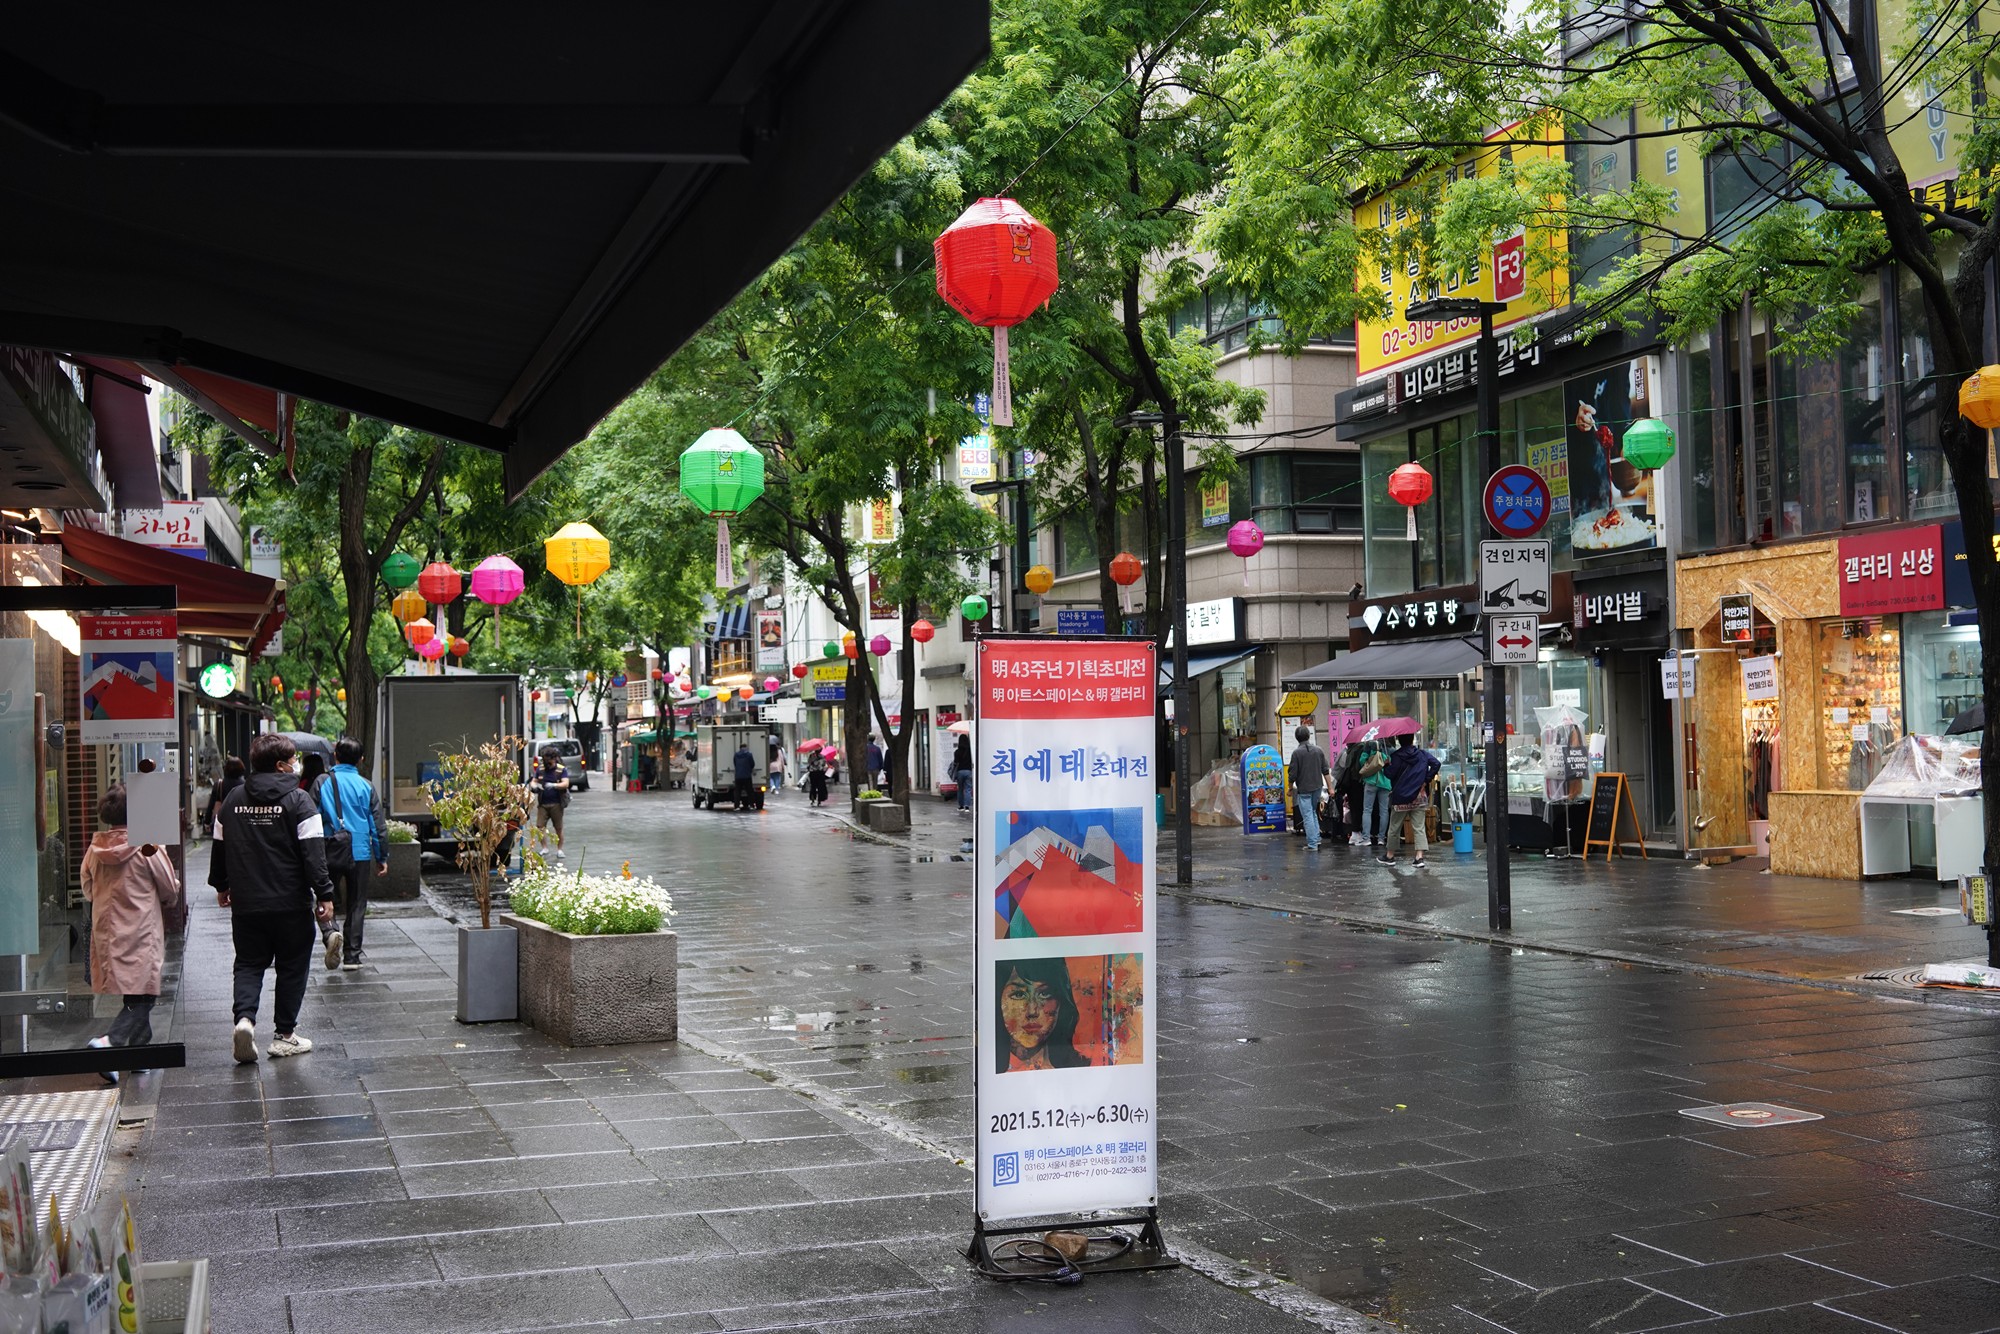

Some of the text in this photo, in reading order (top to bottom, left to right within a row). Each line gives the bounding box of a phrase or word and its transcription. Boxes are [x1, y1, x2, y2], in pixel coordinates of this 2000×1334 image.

[1498, 250, 1521, 284] F3
[1404, 353, 1464, 398] 비와별
[1532, 448, 1548, 465] 상가
[1496, 495, 1543, 507] 주정차금지
[1485, 548, 1546, 564] 견인지역
[1845, 548, 1935, 583] 갤러리 신상
[1386, 600, 1458, 630] 수정공방
[1585, 591, 1642, 624] 비와별
[1059, 612, 1087, 621] 인사동길
[138, 627, 163, 637] 초대전
[1498, 620, 1532, 632] 구간내
[1504, 651, 1527, 660] 100m
[992, 658, 1146, 679] 明 43주년 기획초대전
[1309, 683, 1323, 691] Silver
[1336, 681, 1359, 691] Amethyst
[1373, 681, 1387, 690] Pearl
[1403, 680, 1424, 690] Jewelry
[992, 686, 1146, 703] 明 아트스페이스 & 明 갤러리
[1091, 755, 1149, 779] 초대전
[234, 805, 283, 814] UMBRO
[1024, 1141, 1147, 1161] 明 아트스페이스 & 明 갤러리
[1024, 1161, 1046, 1171] 03163
[1047, 1160, 1068, 1170] 서울시
[1068, 1158, 1088, 1168] 종로구
[1090, 1156, 1117, 1166] 인사동길
[1118, 1155, 1134, 1164] 20길
